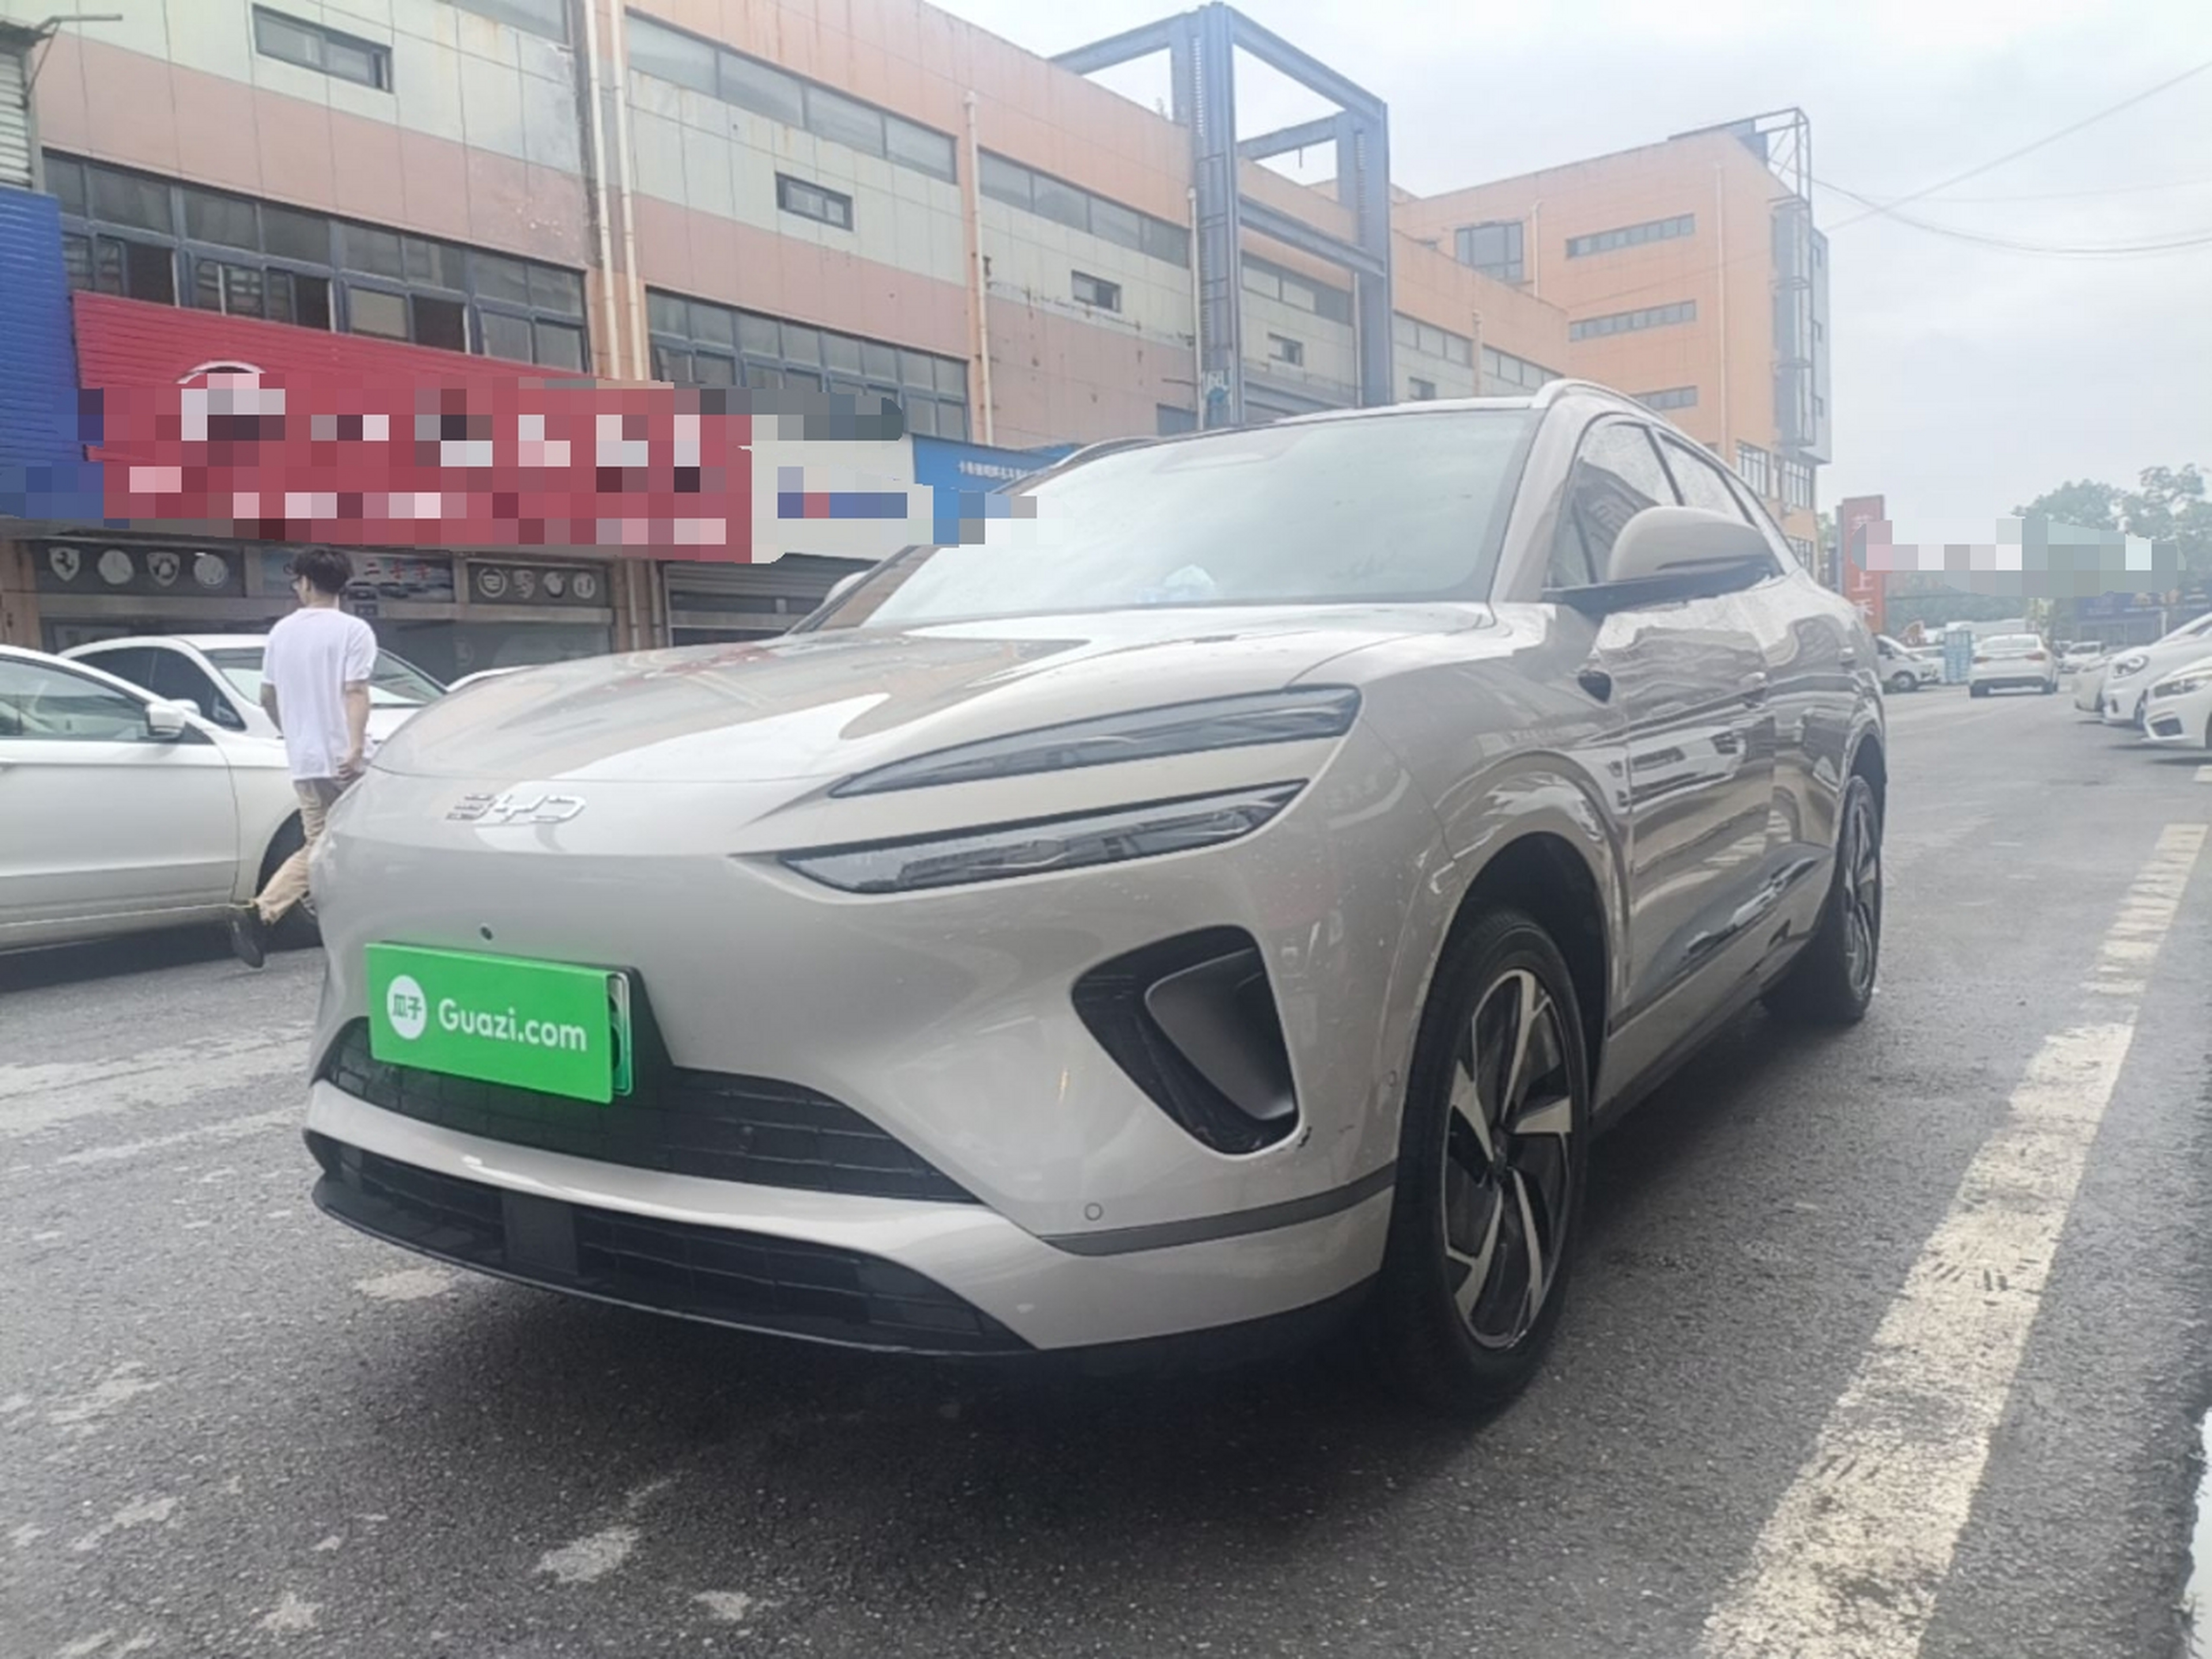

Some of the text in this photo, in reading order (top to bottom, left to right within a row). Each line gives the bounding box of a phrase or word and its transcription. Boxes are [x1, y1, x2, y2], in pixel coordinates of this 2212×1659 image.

[445, 793, 586, 824] BYD
[392, 994, 422, 1020] 瓜子
[438, 997, 587, 1052] Guazi.com
